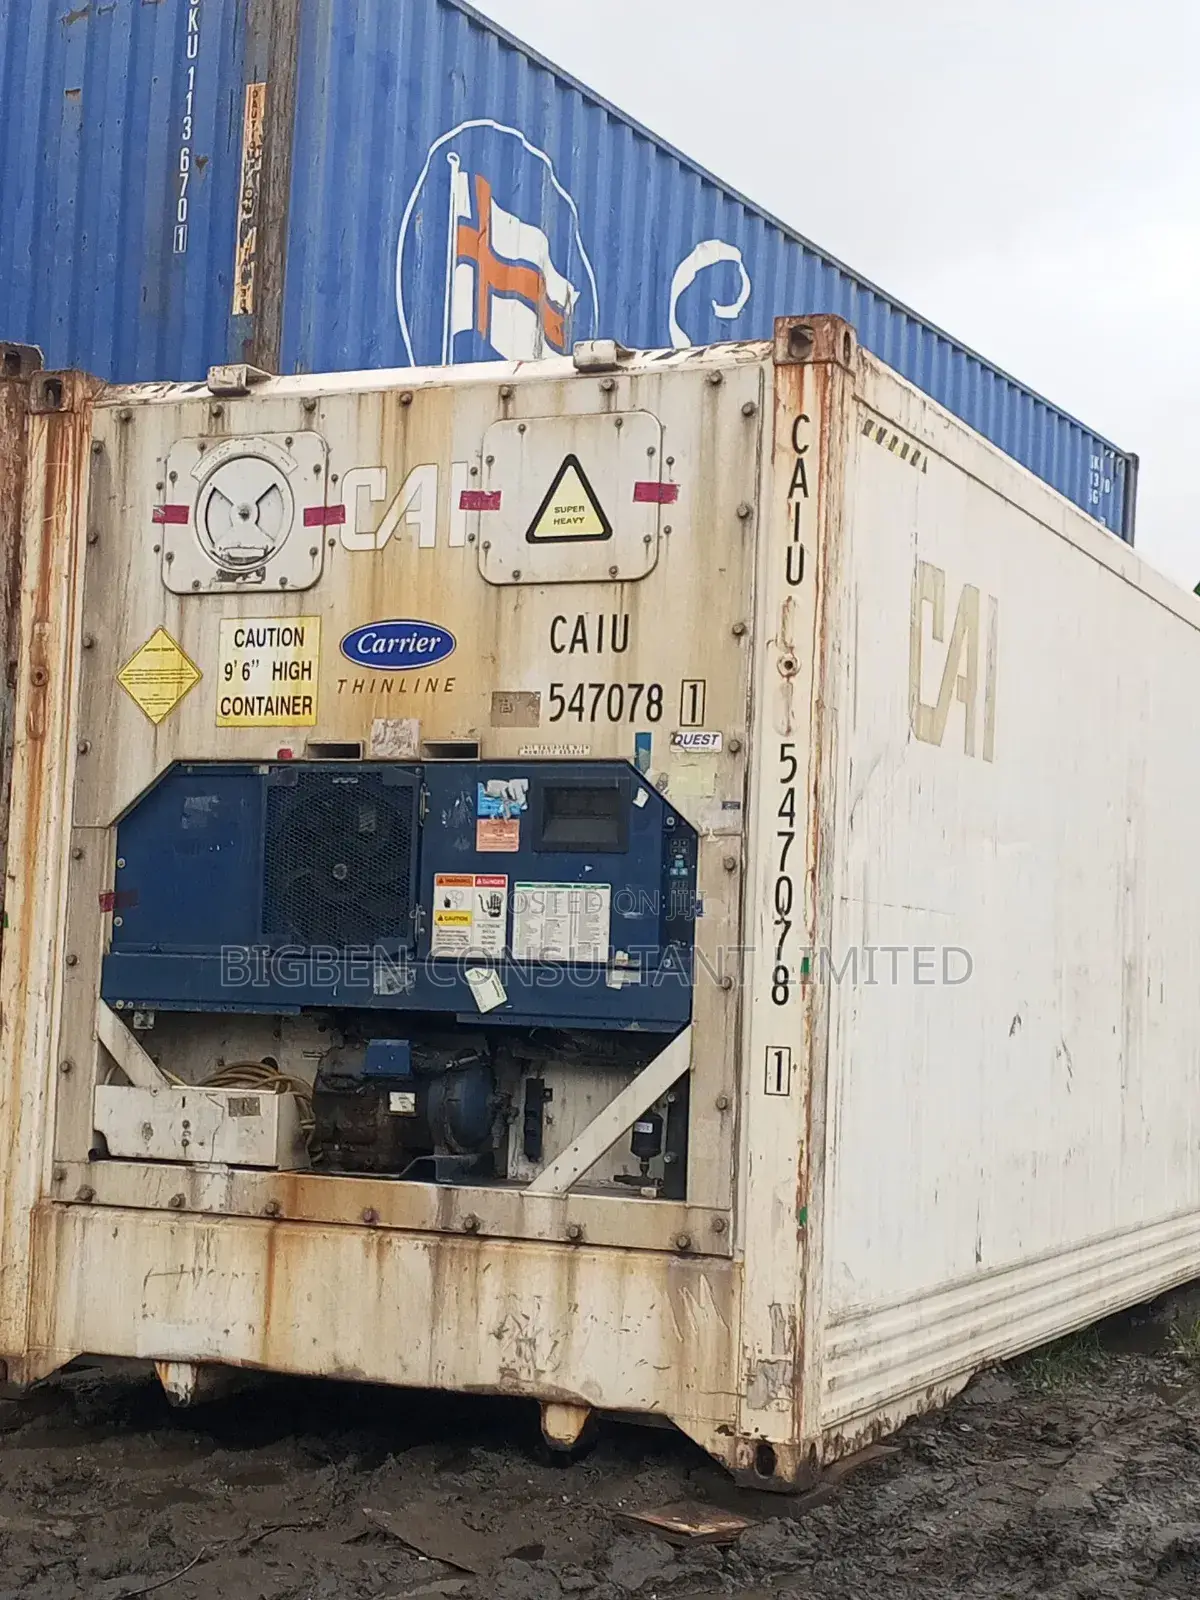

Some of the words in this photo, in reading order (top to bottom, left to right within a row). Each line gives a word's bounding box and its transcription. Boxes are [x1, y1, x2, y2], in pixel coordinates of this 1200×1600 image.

[340, 461, 468, 552] CAI
[554, 505, 585, 514] SUPER
[785, 414, 810, 586] CAIU
[553, 516, 585, 525] HEAVY
[233, 627, 305, 648] CAUTION
[356, 632, 442, 655] Carrier
[550, 613, 631, 654] CAIU
[271, 661, 312, 681] HIGH
[909, 560, 999, 764] CAI
[337, 677, 457, 695] THINLINE
[220, 695, 313, 717] CONTAINER
[549, 683, 663, 723] 547078
[673, 733, 720, 746] QUEST
[771, 743, 798, 1006] 547078
